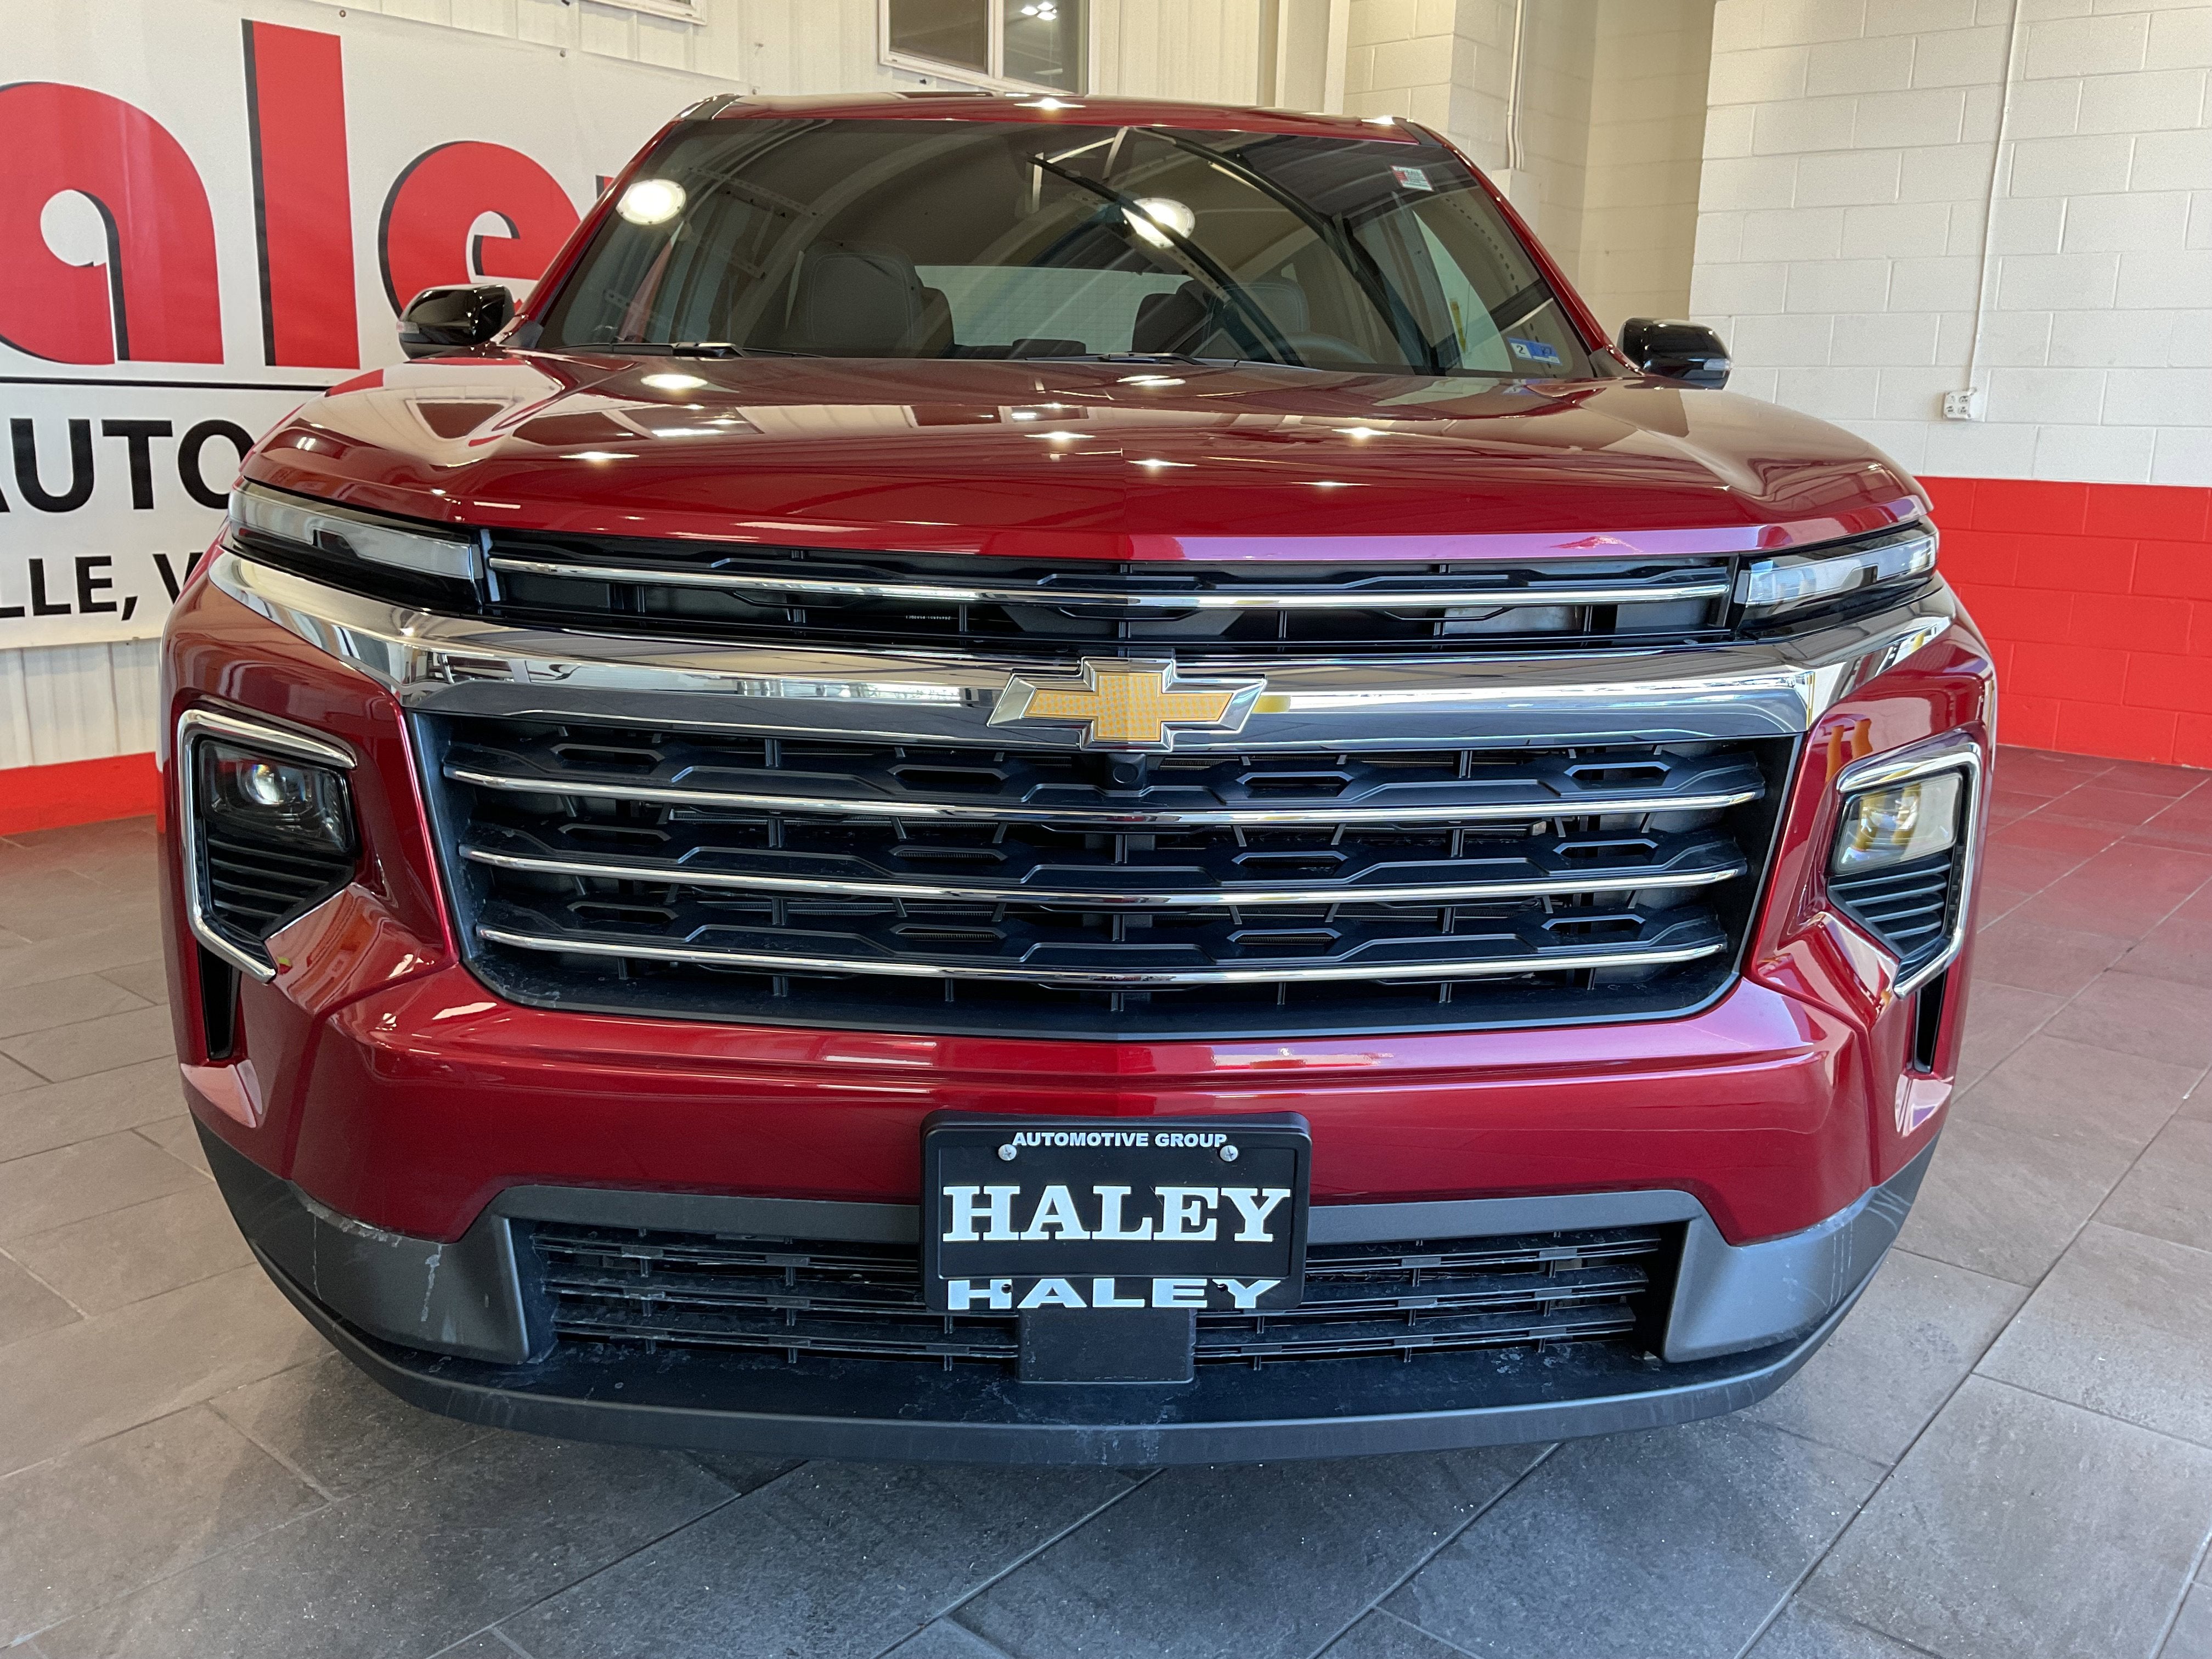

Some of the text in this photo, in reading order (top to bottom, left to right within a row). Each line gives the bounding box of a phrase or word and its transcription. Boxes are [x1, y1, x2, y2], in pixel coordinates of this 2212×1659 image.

[0, 18, 615, 370] ale
[1516, 345, 1526, 354] 2
[0, 418, 256, 513] UTO
[1012, 1132, 1227, 1147] AUTOMOTIVE GROUP
[943, 1185, 1291, 1242] HALEY
[947, 1278, 1281, 1310] HALEY
